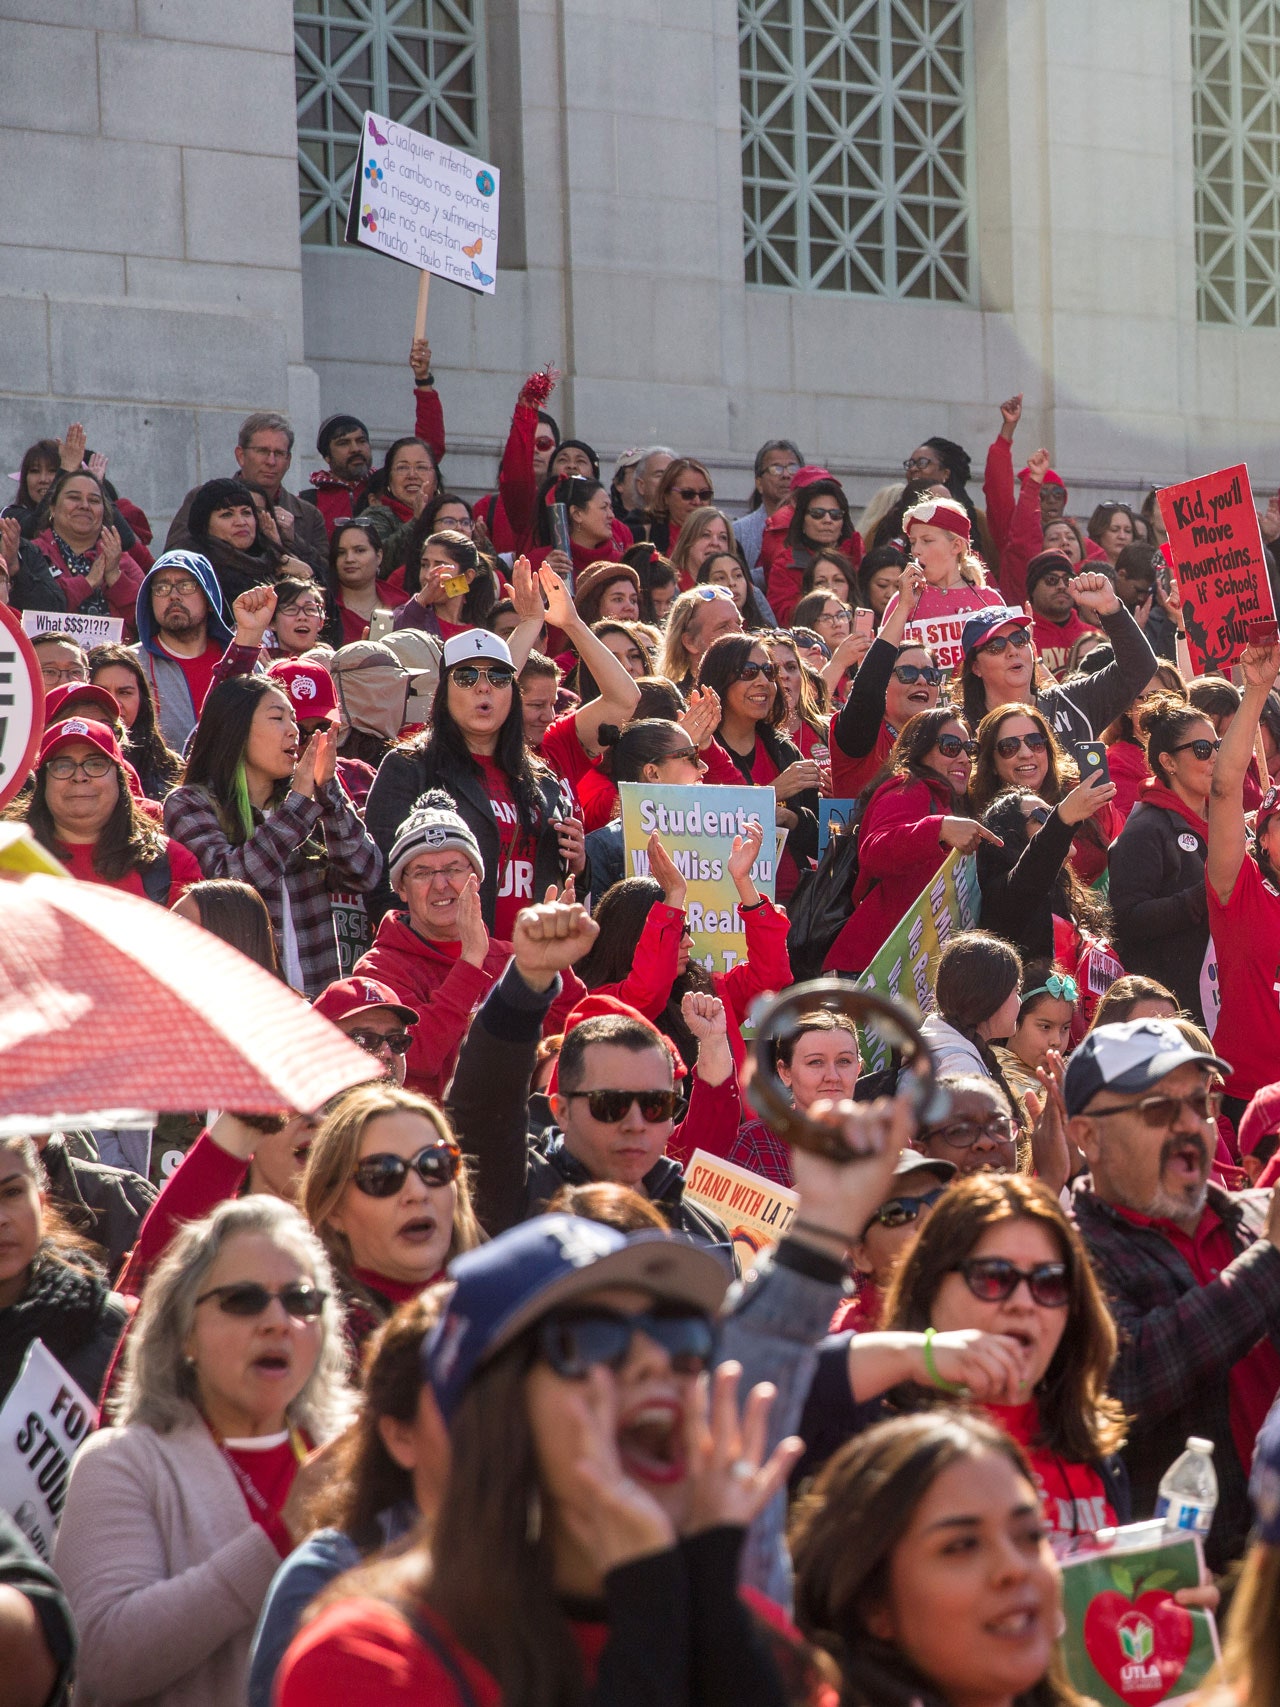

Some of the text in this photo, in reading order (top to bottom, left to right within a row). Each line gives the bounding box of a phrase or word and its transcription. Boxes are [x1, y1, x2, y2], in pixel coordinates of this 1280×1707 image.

[383, 150, 490, 212] de cambio nos expone
[440, 150, 473, 180] intento
[380, 181, 388, 195] a
[392, 185, 431, 215] riesgos
[433, 206, 440, 224] y
[378, 206, 461, 252] que nos cuestan
[1172, 476, 1243, 530] Kid, you'll
[1196, 570, 1258, 605] if Schools
[1236, 594, 1260, 616] had
[36, 614, 110, 636] What $$$?!?!?
[927, 621, 966, 644] STU
[673, 850, 723, 881] Miss
[750, 860, 772, 881] ou
[333, 910, 368, 941] RSE
[688, 1165, 732, 1203] STAND
[728, 1182, 766, 1217] WITH
[760, 1198, 782, 1226] LA
[50, 1383, 96, 1447] FO
[1119, 1664, 1161, 1681] UTLA
